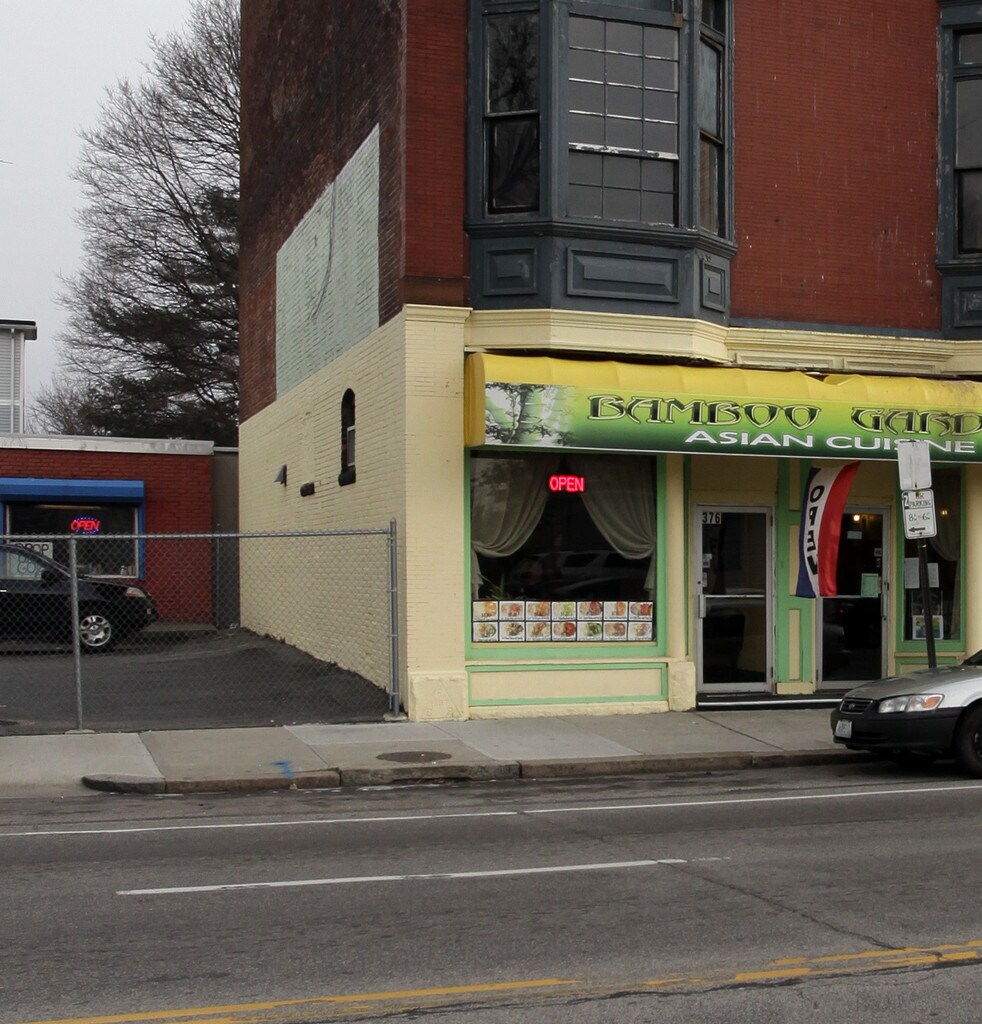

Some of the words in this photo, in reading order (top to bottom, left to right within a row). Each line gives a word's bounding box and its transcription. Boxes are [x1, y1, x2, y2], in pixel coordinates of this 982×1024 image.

[588, 394, 821, 430] BAMBOO
[685, 431, 814, 448] ASIAN
[826, 436, 975, 453] CUINE
[549, 476, 584, 492] OPEN
[903, 494, 910, 507] 2
[909, 499, 932, 508] PARKING
[702, 512, 721, 524] 376
[70, 519, 100, 531] OPEN
